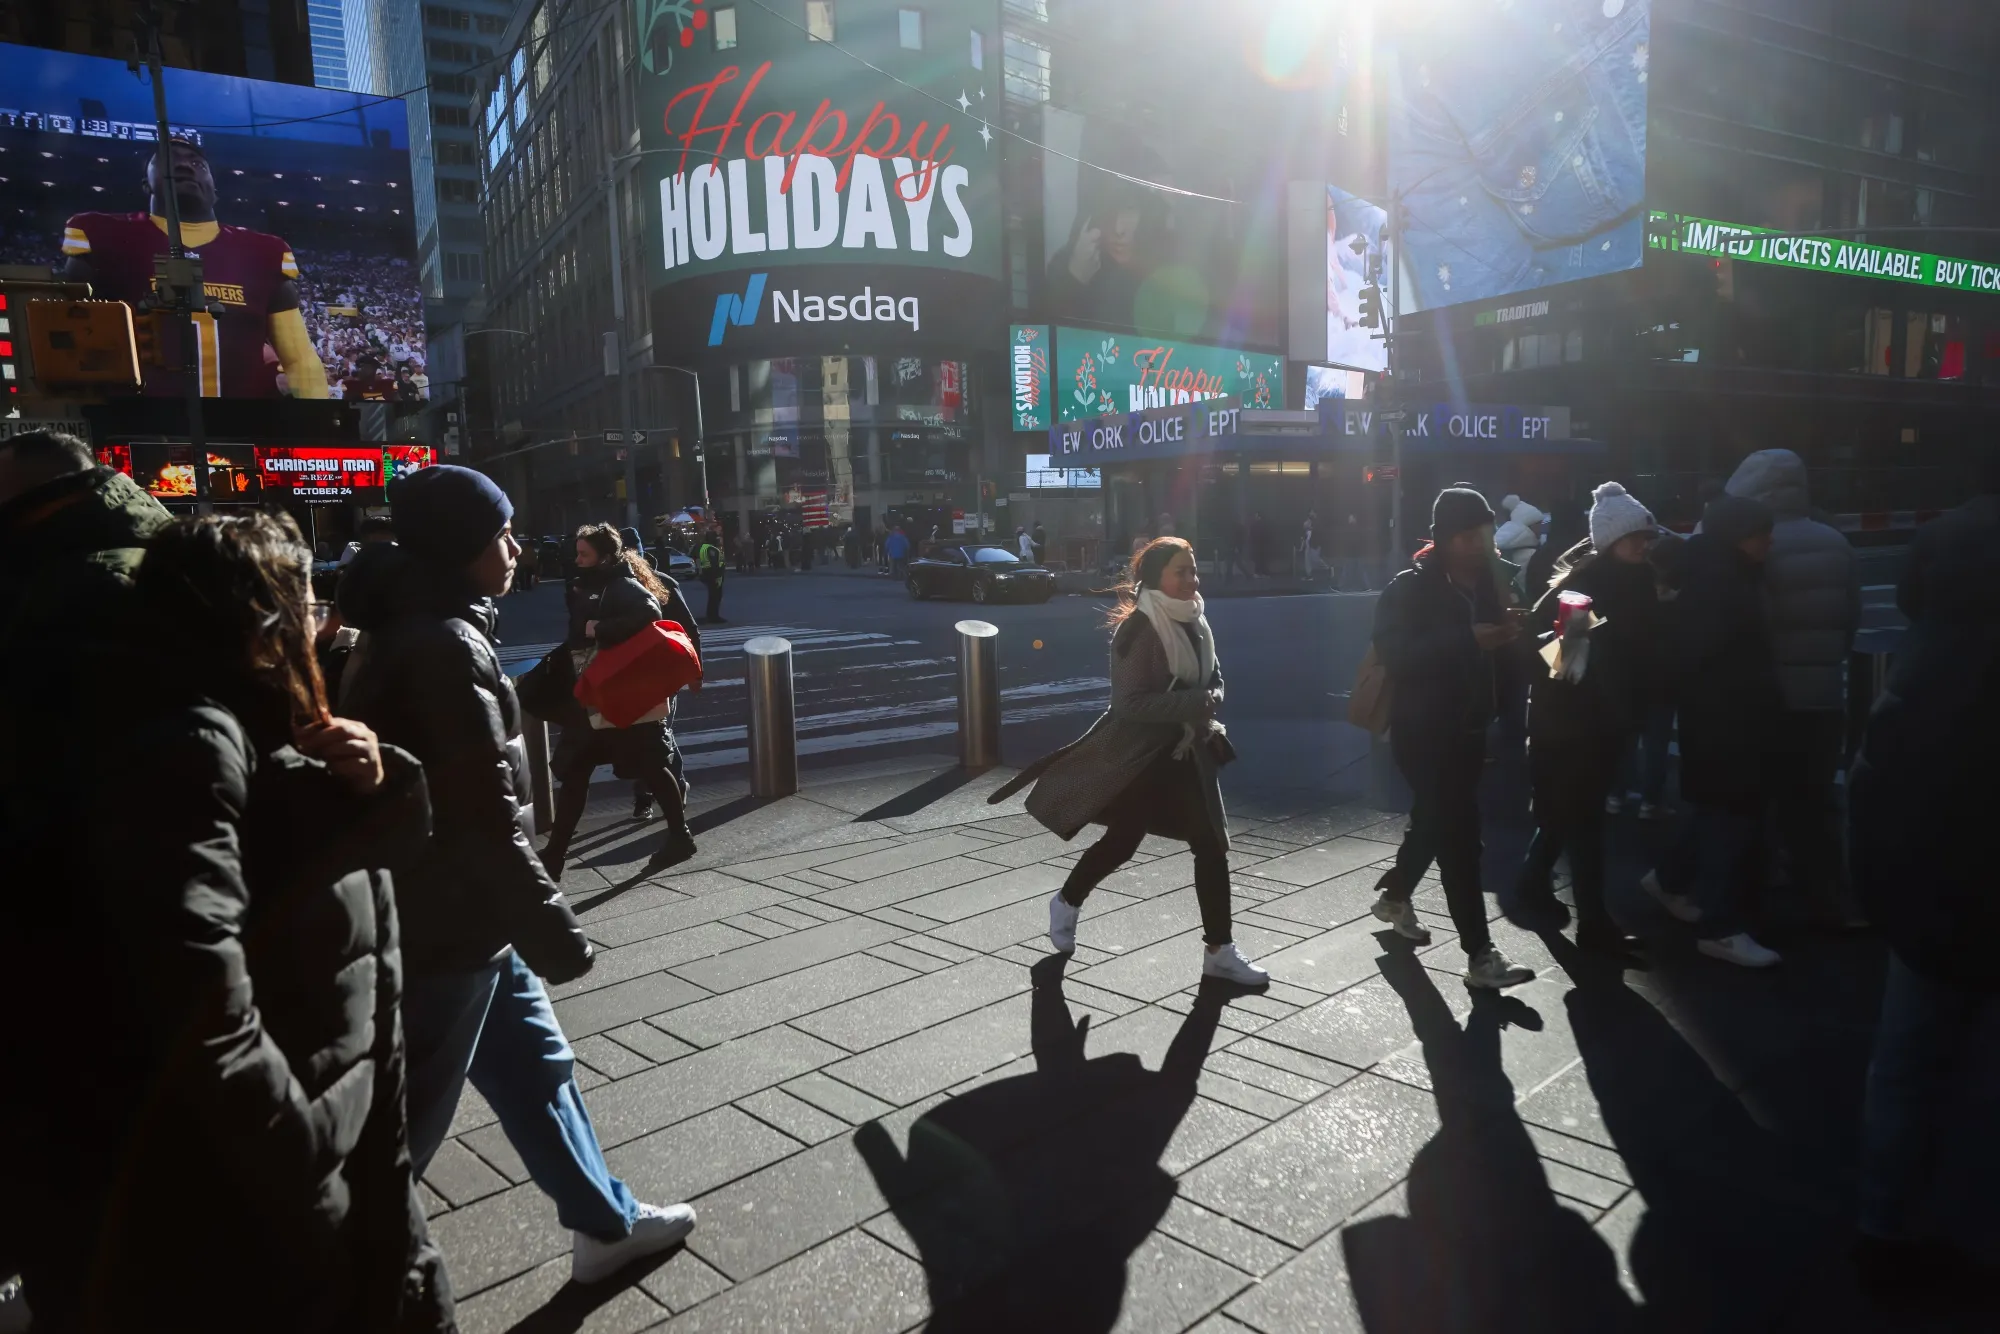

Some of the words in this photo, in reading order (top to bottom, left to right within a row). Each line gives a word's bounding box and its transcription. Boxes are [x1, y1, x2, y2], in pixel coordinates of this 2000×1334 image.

[81, 119, 108, 131] 1:33
[664, 61, 956, 202] Happy
[660, 153, 973, 270] HOLIDAYS
[1760, 233, 1832, 267] TICKETS
[1835, 245, 1923, 280] AVAILABLE.
[1935, 259, 1968, 285] BUY
[772, 286, 920, 332] Nasdaq
[1496, 301, 1549, 323] TRADITION
[1014, 345, 1033, 411] HOLIDAYS
[1133, 346, 1224, 404] Happy
[900, 432, 920, 441] Nasdaq
[265, 458, 338, 472] CHAINSAW
[343, 459, 375, 472] MAN
[293, 487, 338, 495] OCTOBER
[340, 487, 352, 495] 24
